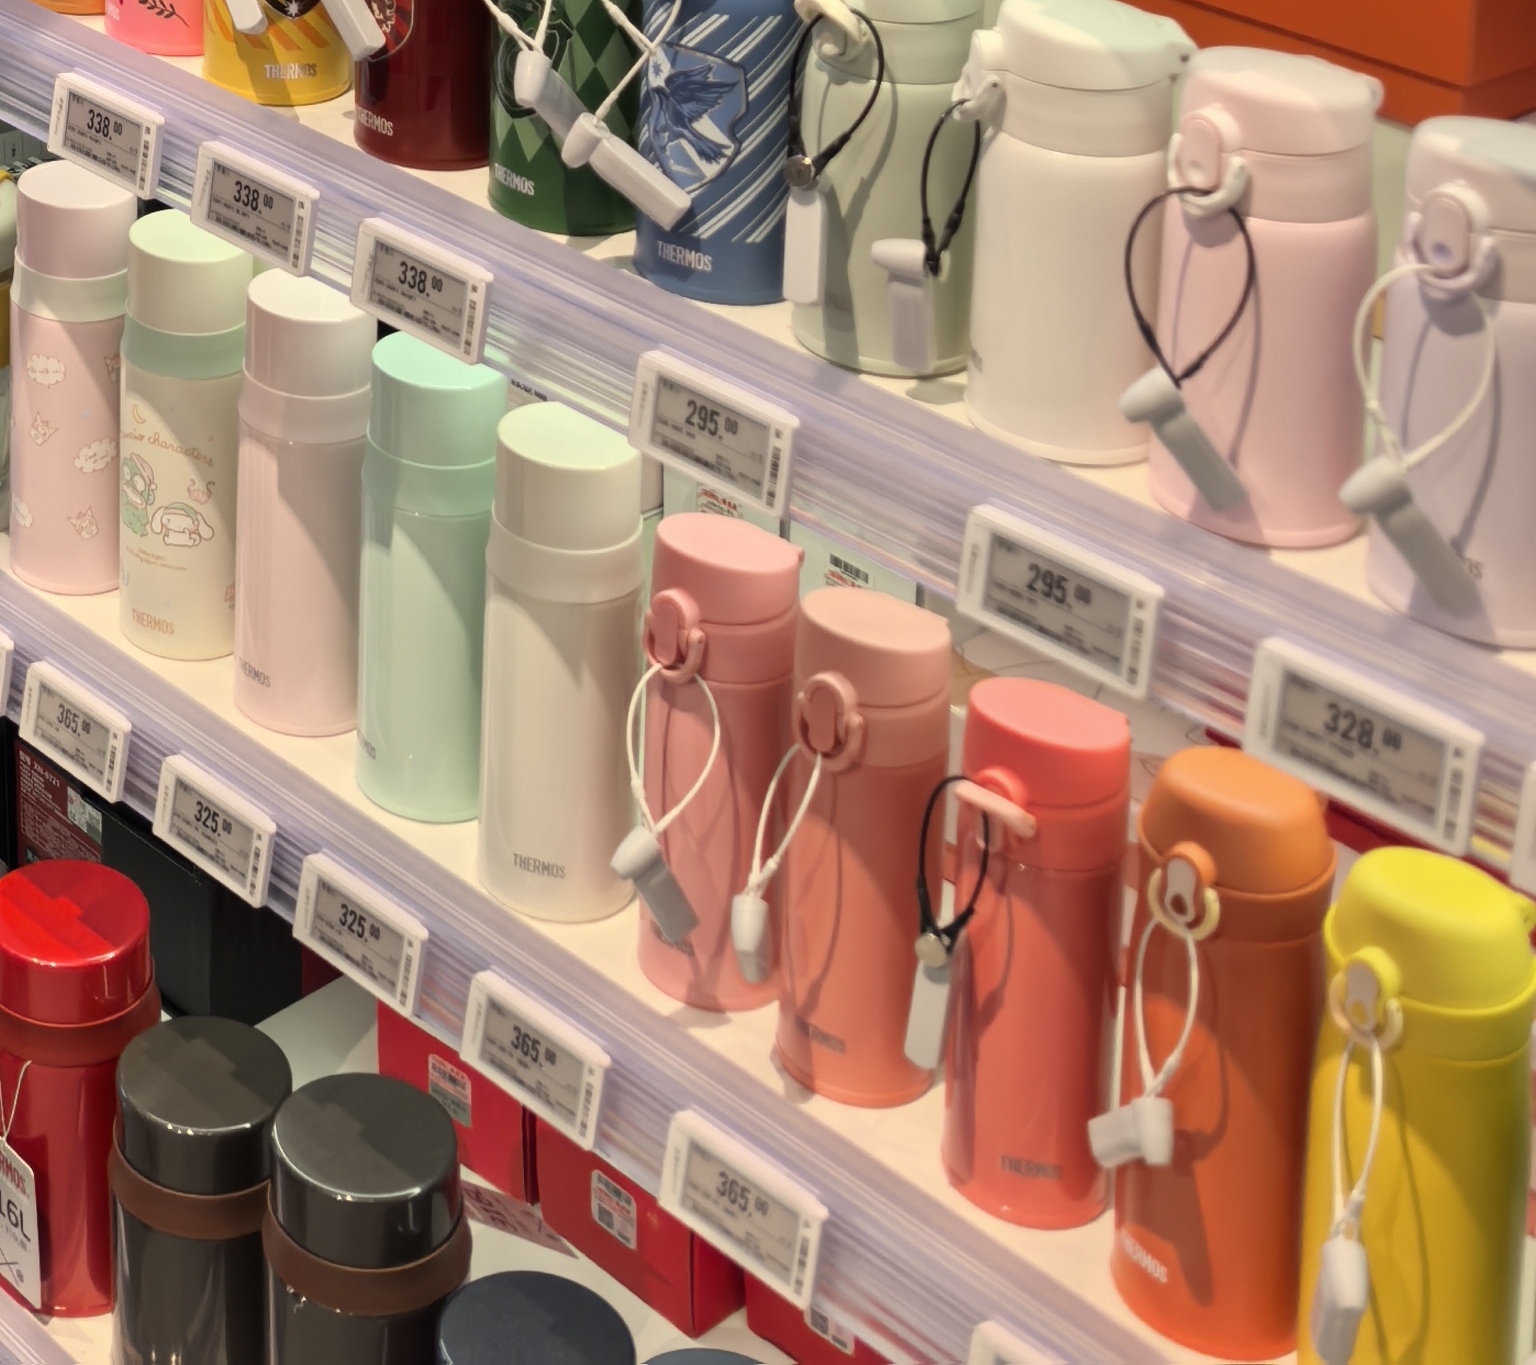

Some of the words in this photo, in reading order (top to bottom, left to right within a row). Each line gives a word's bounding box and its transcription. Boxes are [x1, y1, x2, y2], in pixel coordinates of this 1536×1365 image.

[264, 62, 318, 80] THERMOS
[88, 108, 124, 140] 338.00
[355, 106, 394, 137] THERMOS
[232, 180, 275, 215] 338.00
[493, 164, 535, 197] THERMOS
[657, 238, 713, 272] THERMOS
[398, 260, 444, 299] 338.00
[684, 399, 740, 441] 295.00
[148, 432, 215, 469] characters
[1026, 563, 1093, 610] 295.00
[131, 607, 177, 636] THERMOS
[57, 702, 91, 738] 365.00
[194, 798, 233, 837] 325.00
[513, 852, 567, 880] THERMOS
[338, 902, 382, 945] 325.00
[509, 1023, 558, 1068] 365.00
